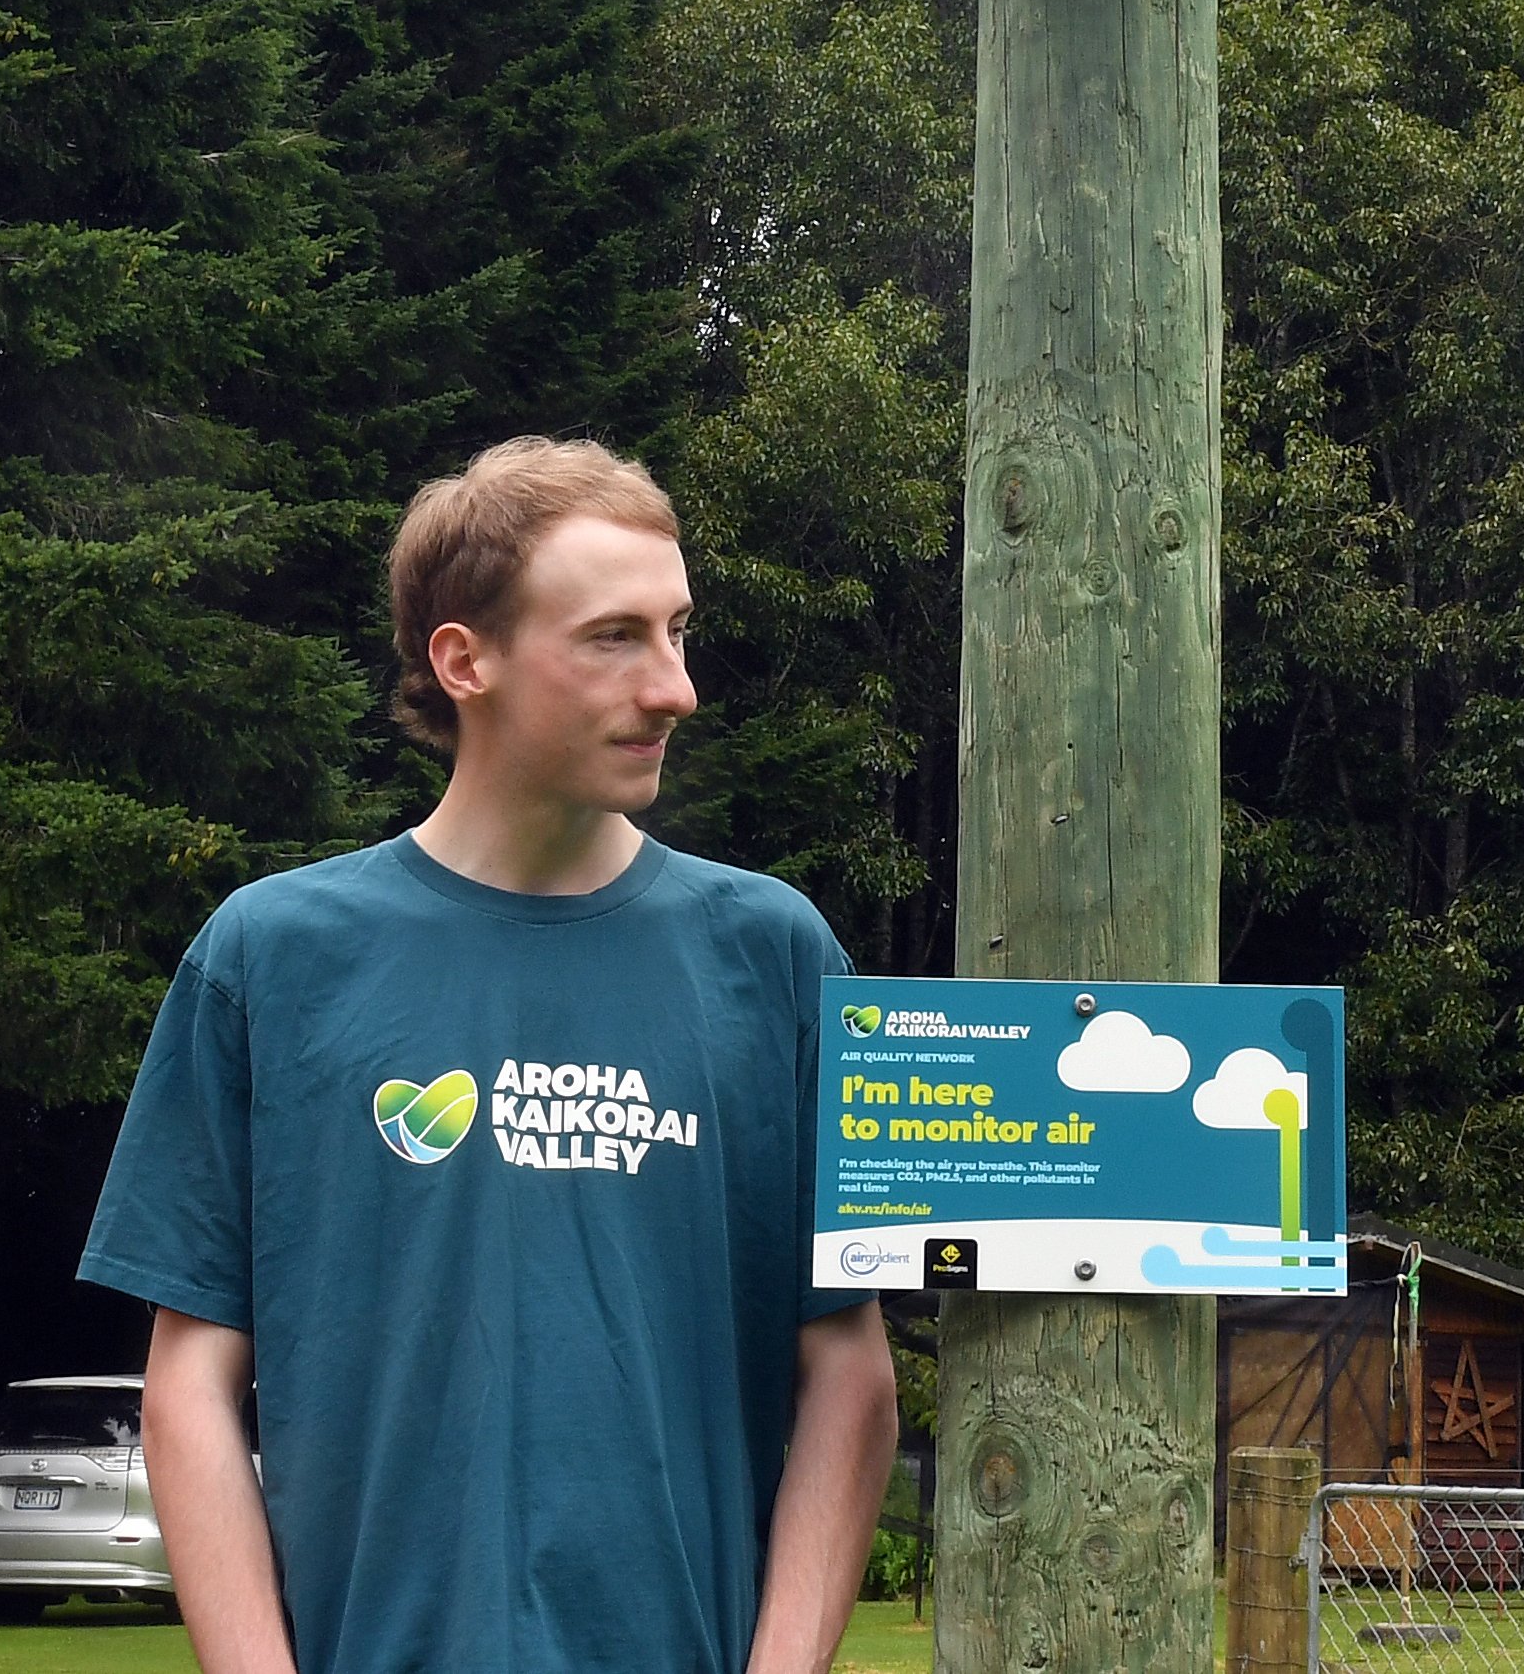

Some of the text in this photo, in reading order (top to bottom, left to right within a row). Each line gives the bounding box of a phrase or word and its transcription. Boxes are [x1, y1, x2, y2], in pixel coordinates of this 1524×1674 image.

[886, 1010, 948, 1024] AROHA
[884, 1023, 1031, 1040] KAIKORAI VALLEY
[840, 1051, 976, 1064] AIR QUALITY NETWORK
[493, 1058, 651, 1103] AROHA
[841, 1075, 994, 1106] I'm here
[491, 1093, 699, 1147] KAIKORAI
[840, 1111, 1096, 1145] to monitor air
[492, 1128, 652, 1176] VALLEY
[859, 1158, 913, 1171] checking
[915, 1159, 936, 1170] the
[937, 1159, 953, 1170] air
[954, 1161, 977, 1172] you
[978, 1160, 1027, 1171] breathe.
[1028, 1161, 1053, 1172] This
[1054, 1161, 1101, 1173] monitor
[838, 1172, 895, 1181] measures
[896, 1171, 924, 1183] CO2,
[965, 1173, 988, 1183] and
[989, 1173, 1021, 1183] other
[1022, 1173, 1081, 1186] pollutants
[1083, 1173, 1096, 1184] in
[838, 1182, 890, 1193] real time
[850, 1252, 910, 1265] airgradient
